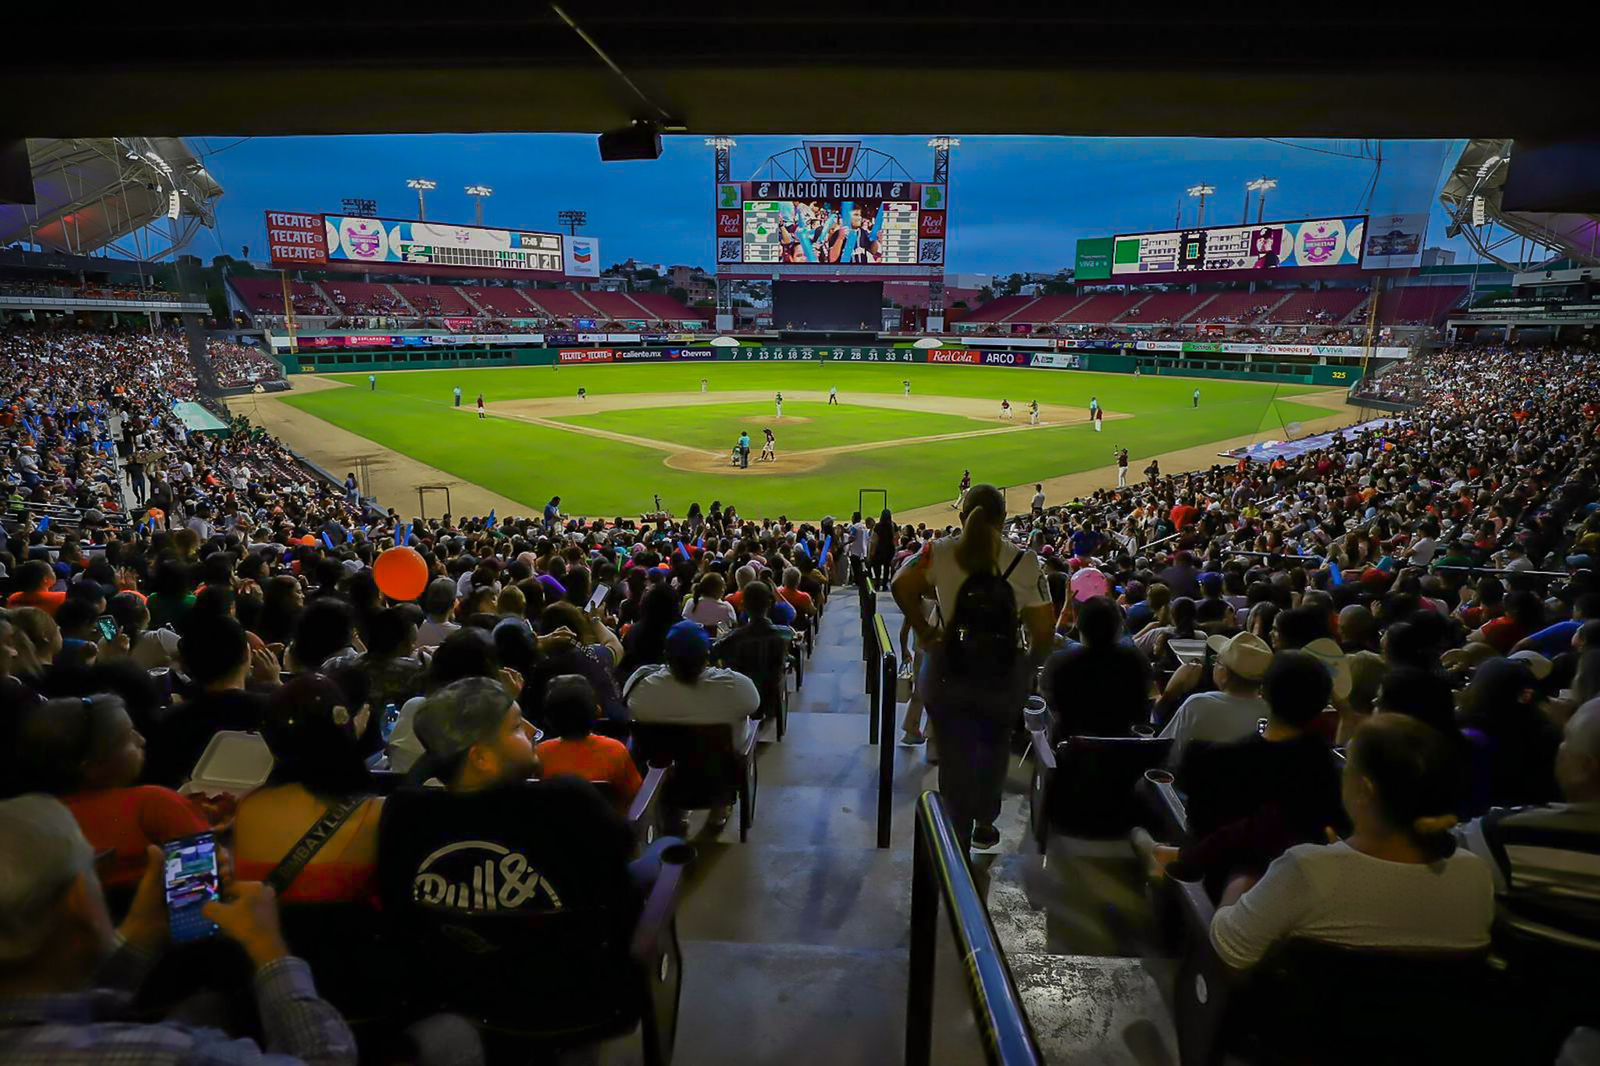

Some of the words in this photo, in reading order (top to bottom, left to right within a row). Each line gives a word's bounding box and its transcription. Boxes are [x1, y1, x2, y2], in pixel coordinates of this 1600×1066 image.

[778, 181, 827, 198] NACIÓN
[833, 183, 882, 198] GUINDA
[268, 214, 312, 228] TECATE
[720, 214, 740, 226] Red
[922, 216, 942, 226] Red
[270, 230, 314, 244] TECATE
[272, 246, 316, 259] TECATE
[986, 353, 1014, 364] ARCO
